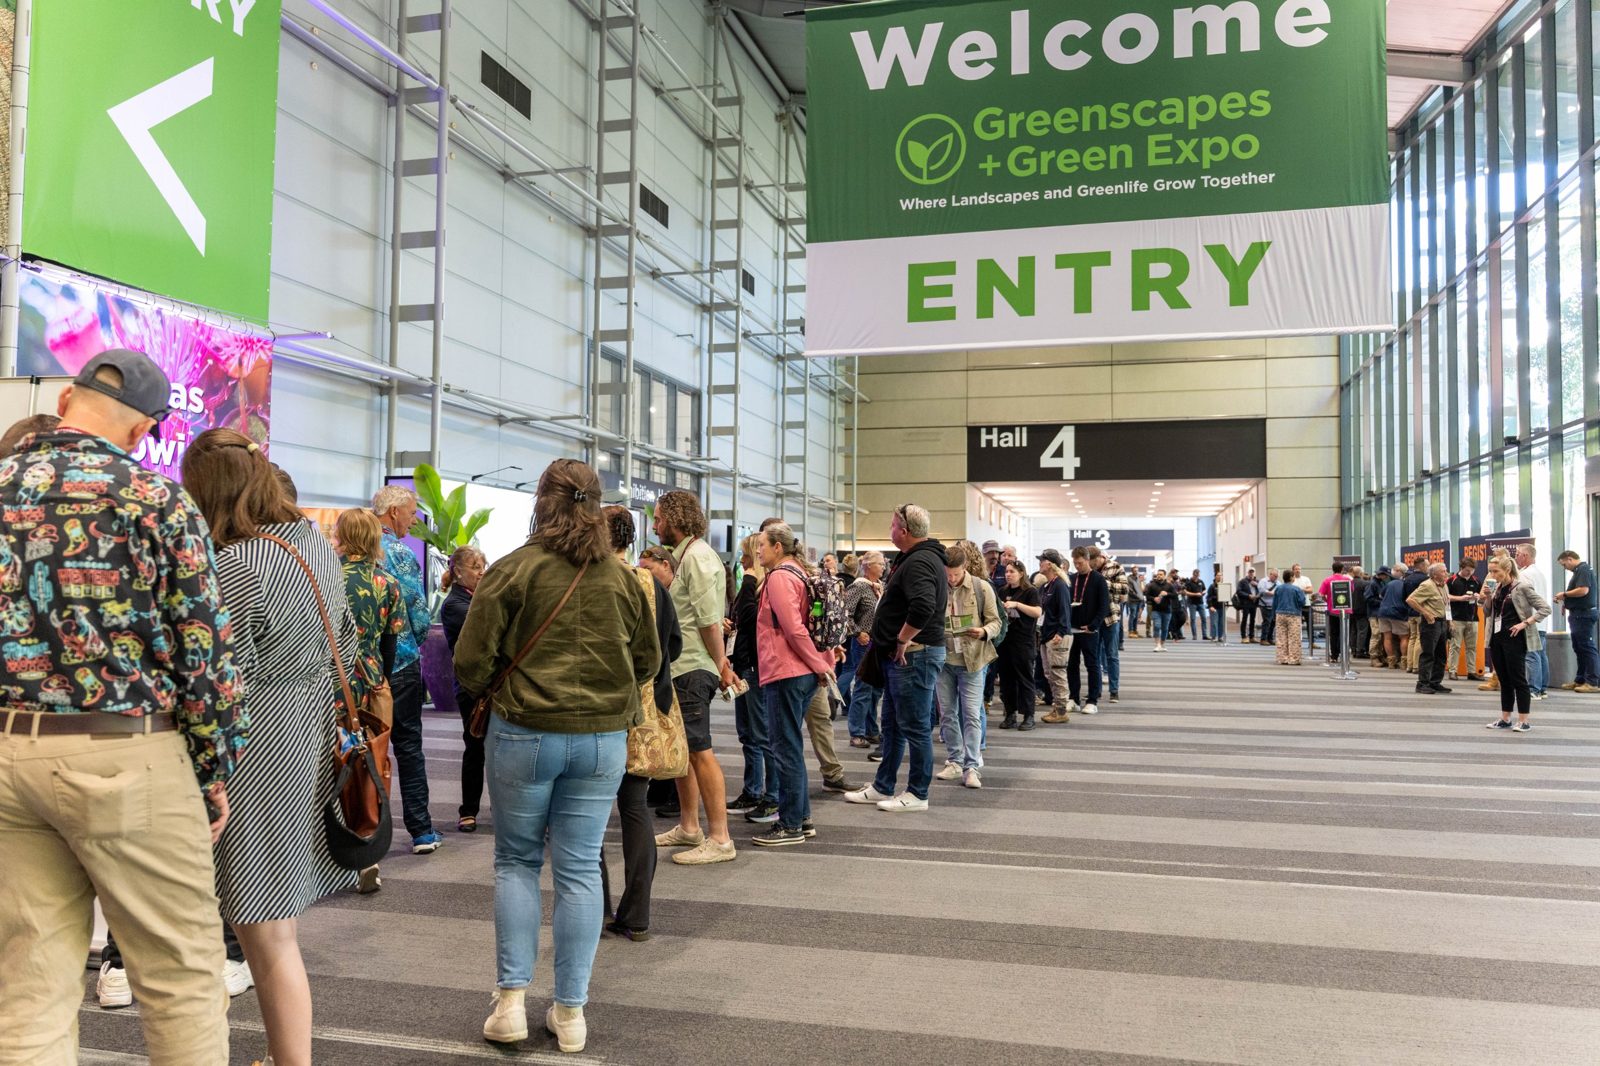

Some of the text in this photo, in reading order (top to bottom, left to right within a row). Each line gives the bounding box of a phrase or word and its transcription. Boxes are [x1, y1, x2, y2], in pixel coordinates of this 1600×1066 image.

[850, 0, 1332, 91] Welcome
[973, 90, 1272, 141] Greenscapes
[1147, 134, 1260, 169] Expo
[899, 172, 1276, 210] Where Landscapes and Greenlife Grow Together
[907, 241, 1272, 323] ENTRY
[980, 425, 1081, 480] Hall 4
[1073, 530, 1111, 549] Hall 3
[1429, 548, 1445, 564] HERE
